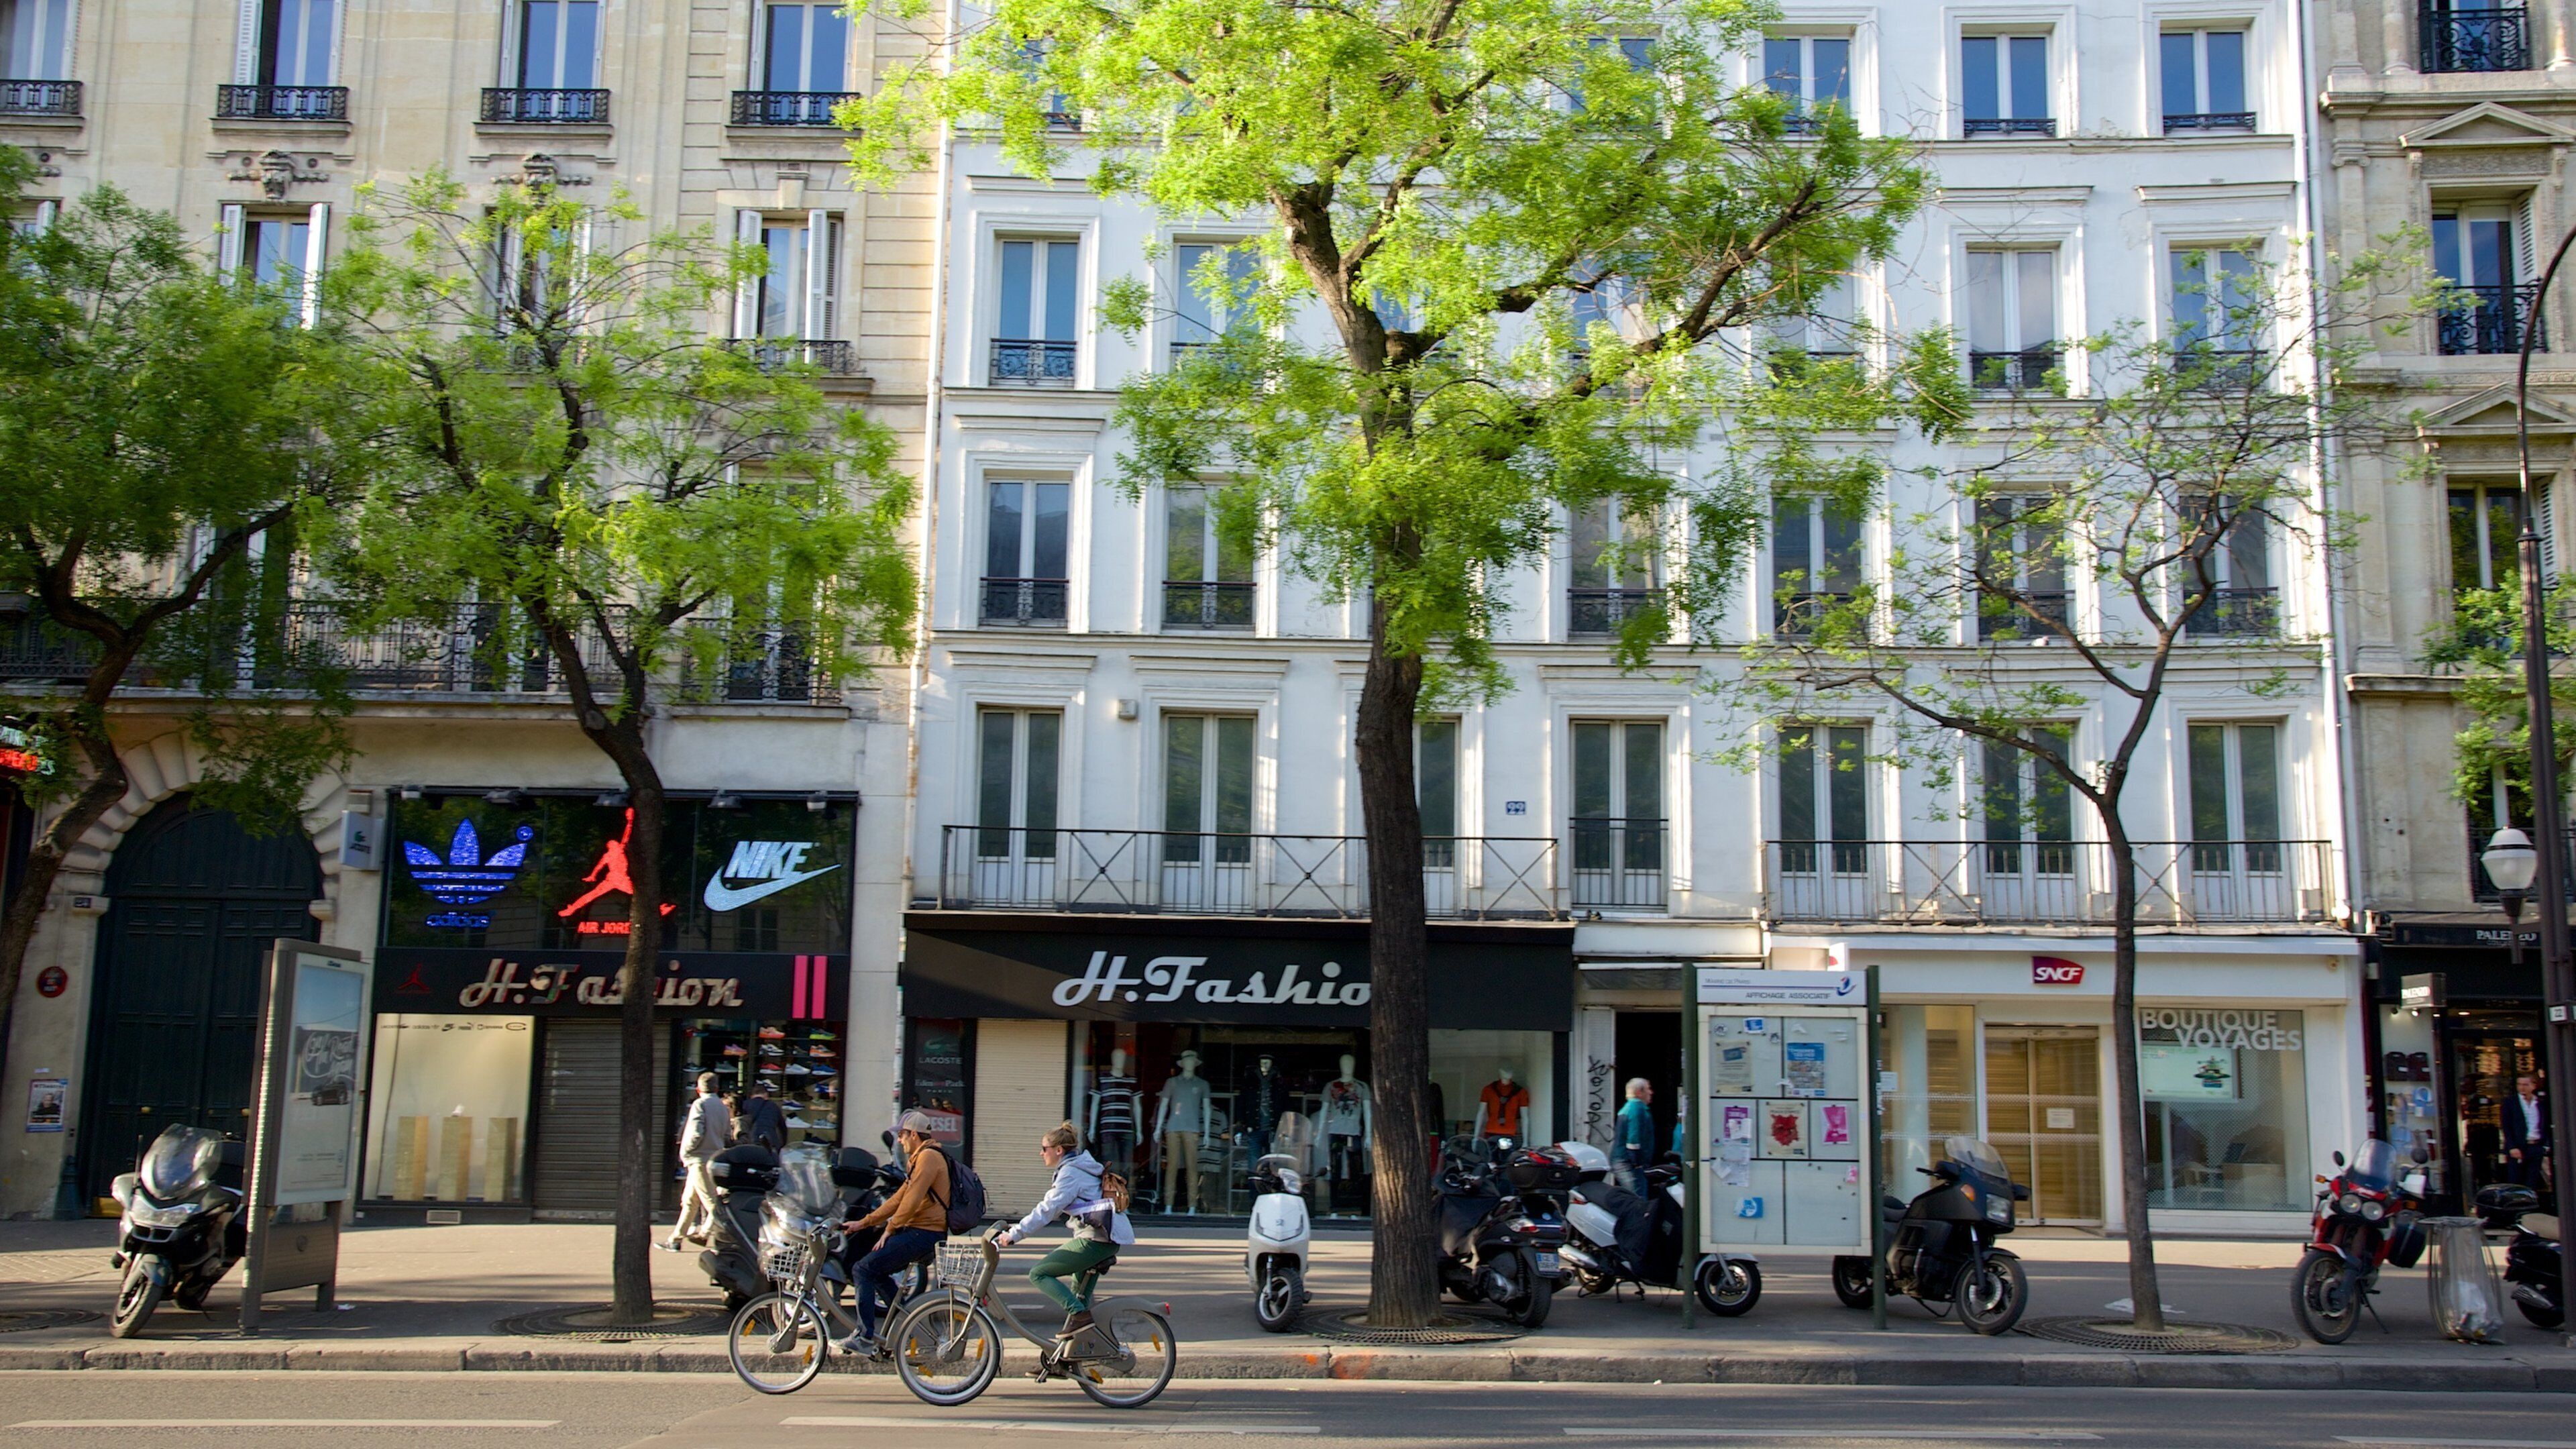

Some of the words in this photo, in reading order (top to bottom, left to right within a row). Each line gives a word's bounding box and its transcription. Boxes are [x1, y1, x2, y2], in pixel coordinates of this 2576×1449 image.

[1507, 802, 1524, 814] 22
[724, 841, 814, 878] NIKE
[577, 922, 600, 933] AIR
[1052, 951, 1372, 1006] H.Fashio
[2034, 967, 2082, 981] SNCF
[2142, 1009, 2277, 1030] BOUTIQUE
[2176, 1028, 2302, 1051] VOYAGES
[930, 1116, 958, 1132] ESEL
